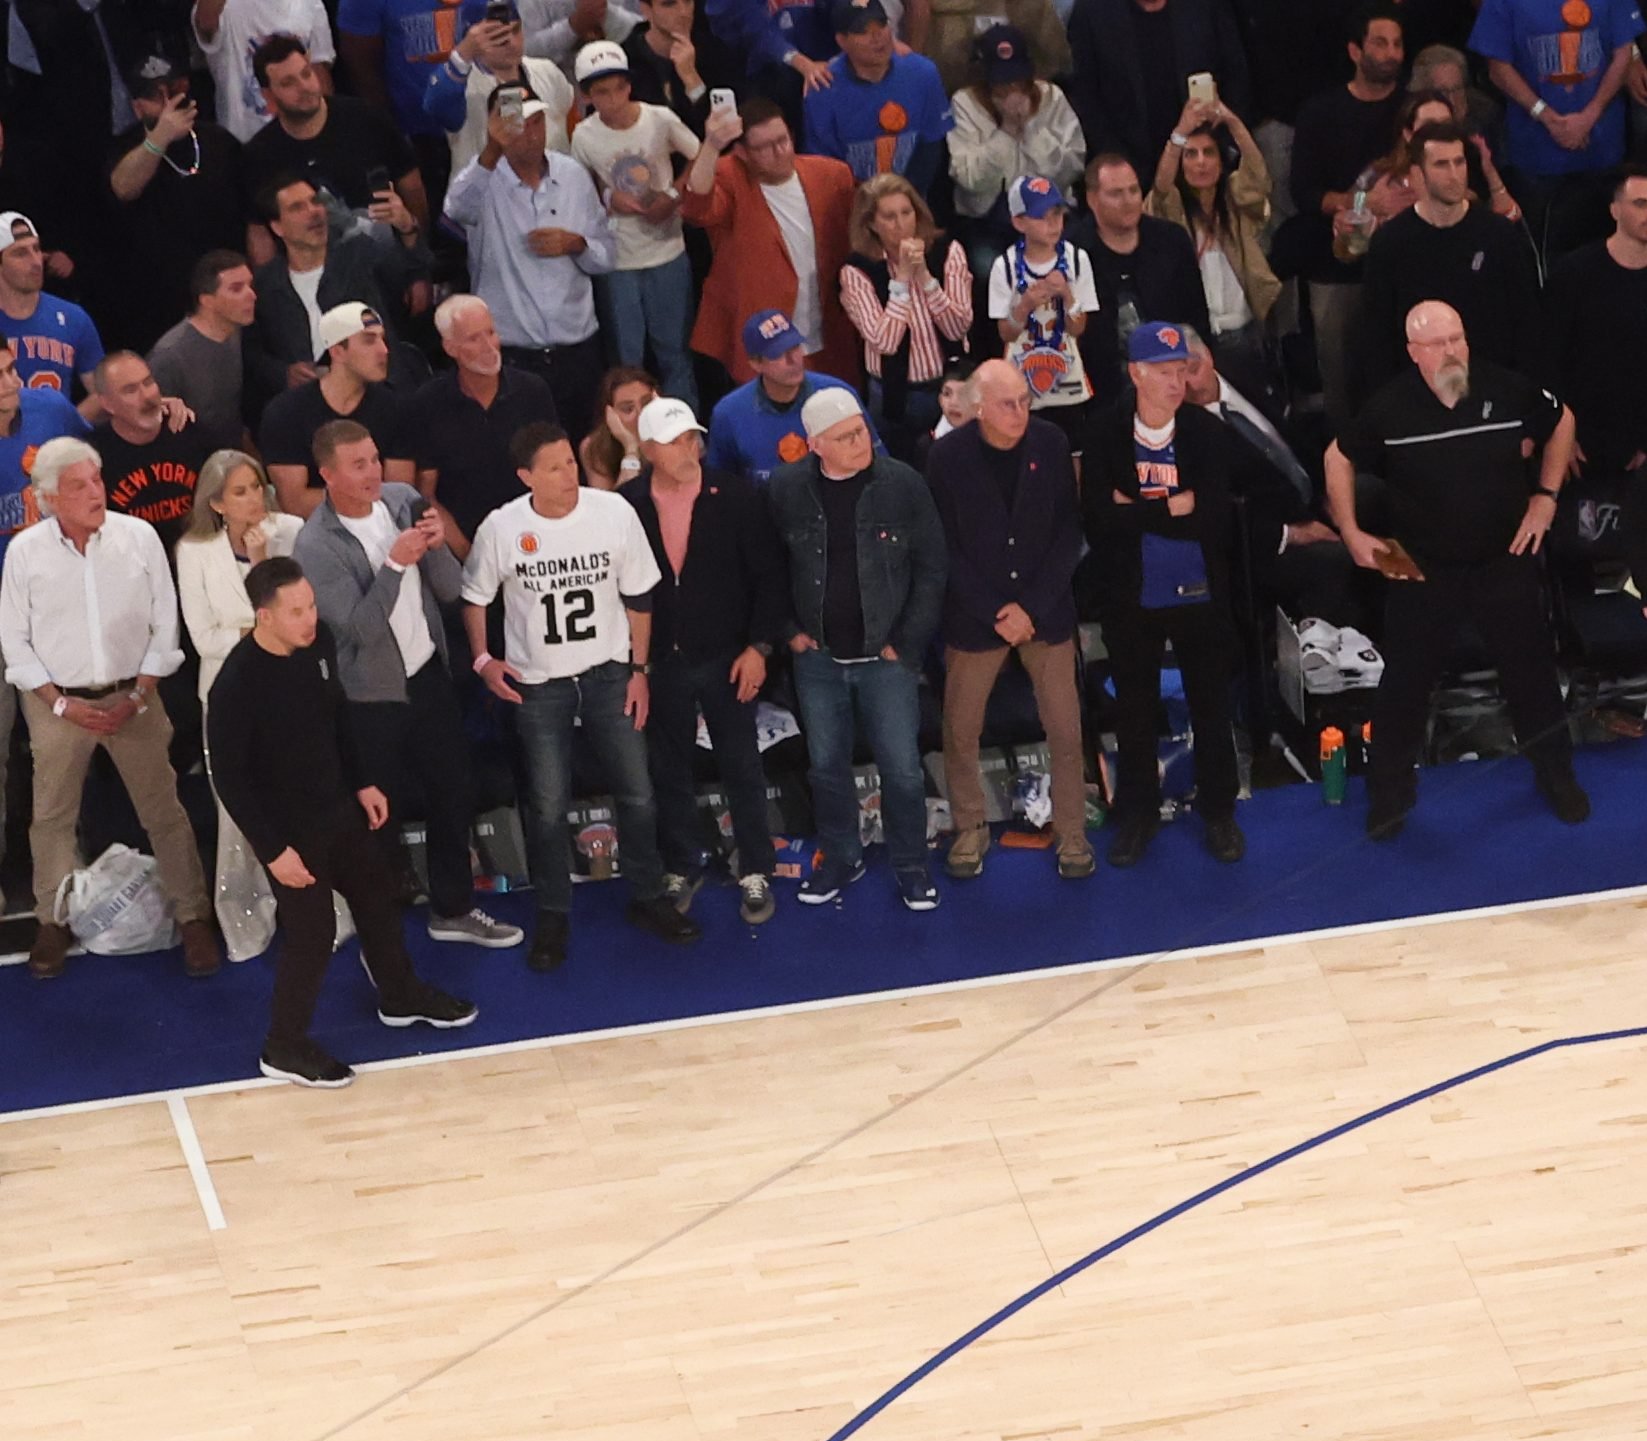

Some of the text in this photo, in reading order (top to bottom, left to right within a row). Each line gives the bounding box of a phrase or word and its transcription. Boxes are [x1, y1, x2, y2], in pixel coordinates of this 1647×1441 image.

[111, 461, 198, 508] NEW YORK
[516, 551, 610, 578] McDONALD'S
[523, 571, 609, 593] ALL AMERICAN
[540, 588, 597, 645] 12
